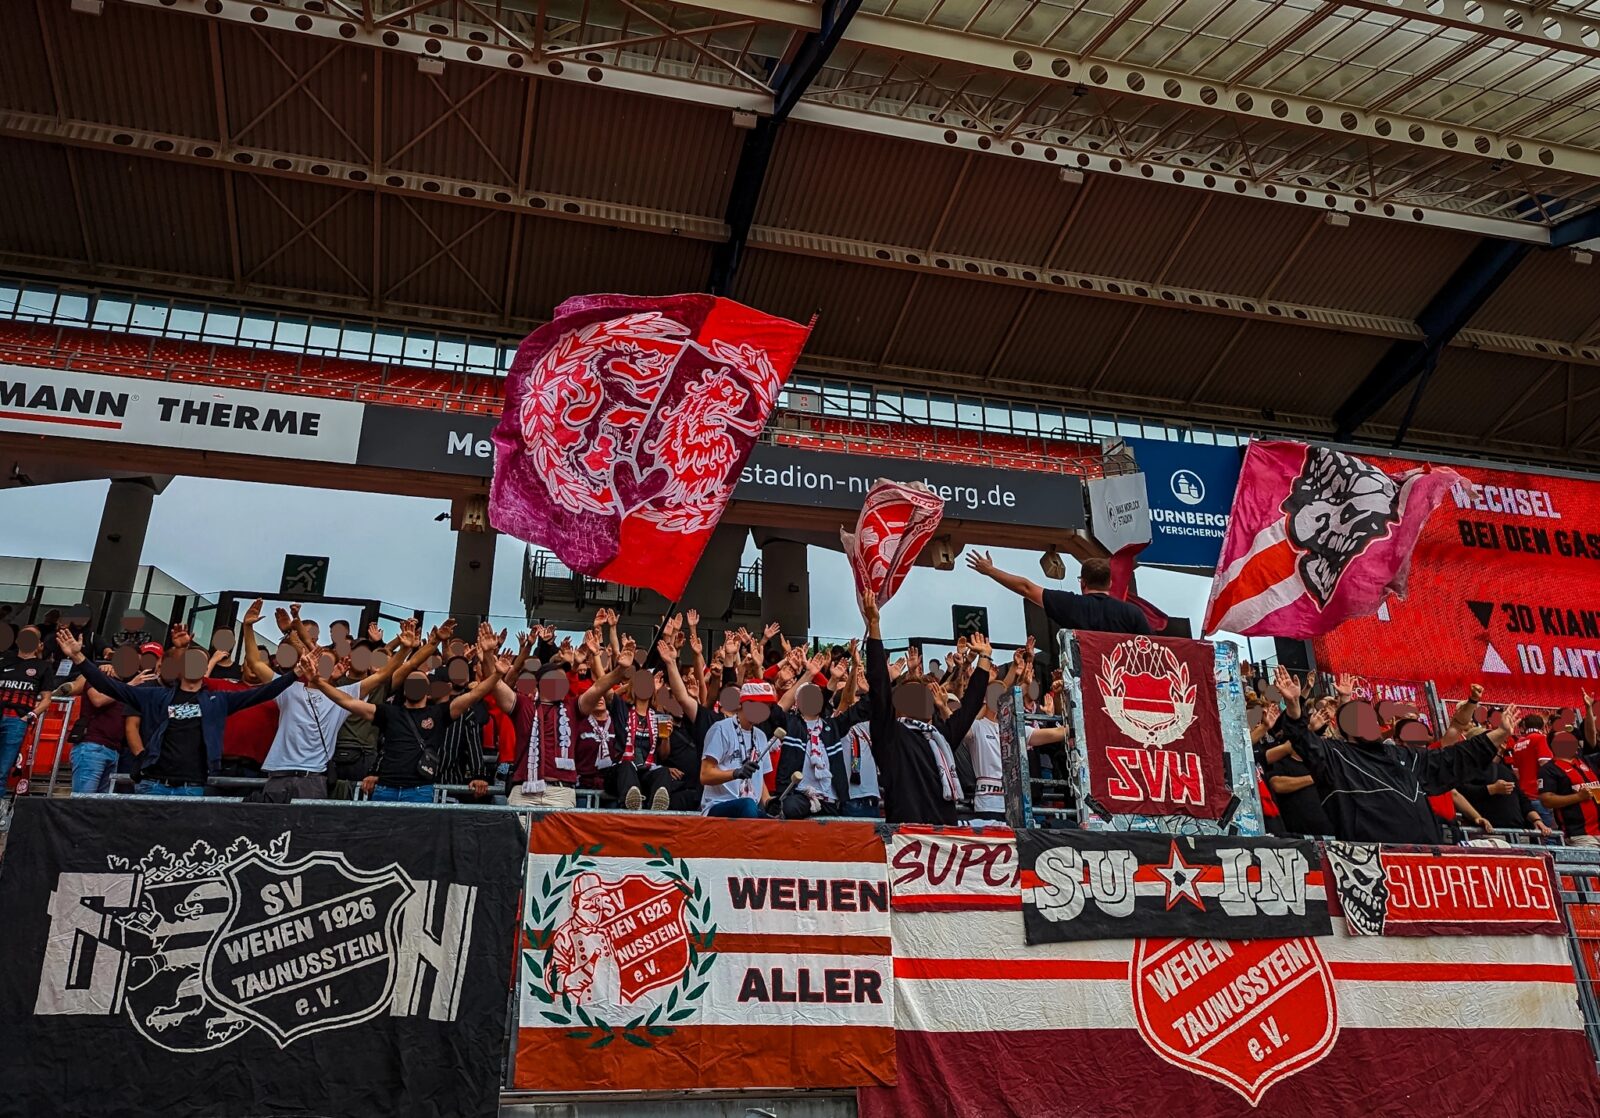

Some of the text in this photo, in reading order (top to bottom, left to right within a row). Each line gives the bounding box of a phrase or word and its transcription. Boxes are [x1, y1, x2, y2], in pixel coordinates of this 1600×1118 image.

[0, 380, 320, 437] MANN THERME
[447, 431, 1016, 509] Me stadion-nuberg.de
[1451, 482, 1562, 519] WECHSEL
[1158, 525, 1226, 538] VERSICHERUN
[1458, 520, 1500, 549] BEI
[1502, 524, 1552, 555] DEN
[1501, 602, 1537, 634] 30
[1516, 643, 1600, 679] 10 ANT
[5, 680, 34, 691] BRITA
[1105, 746, 1205, 806] SVW
[892, 840, 1020, 888] SUPC
[1034, 846, 1310, 923] SU IN
[264, 876, 302, 917] SV
[602, 889, 626, 917] SV
[727, 877, 889, 912] WEHEN
[1386, 864, 1550, 910] SUPREMUS
[223, 897, 376, 965] WEHEN 1926
[610, 898, 672, 940] HEN 1926
[617, 921, 680, 964] NUSSTEIN
[231, 931, 384, 999] TAUNUSSTEIN
[634, 959, 661, 983] e.V.
[737, 967, 883, 1004] ALLER
[1145, 938, 1235, 1003] WEHEN
[295, 986, 339, 1016] e.V.
[1171, 938, 1311, 1048] TAUNUSSTEIN
[1247, 1015, 1290, 1062] e.V.
